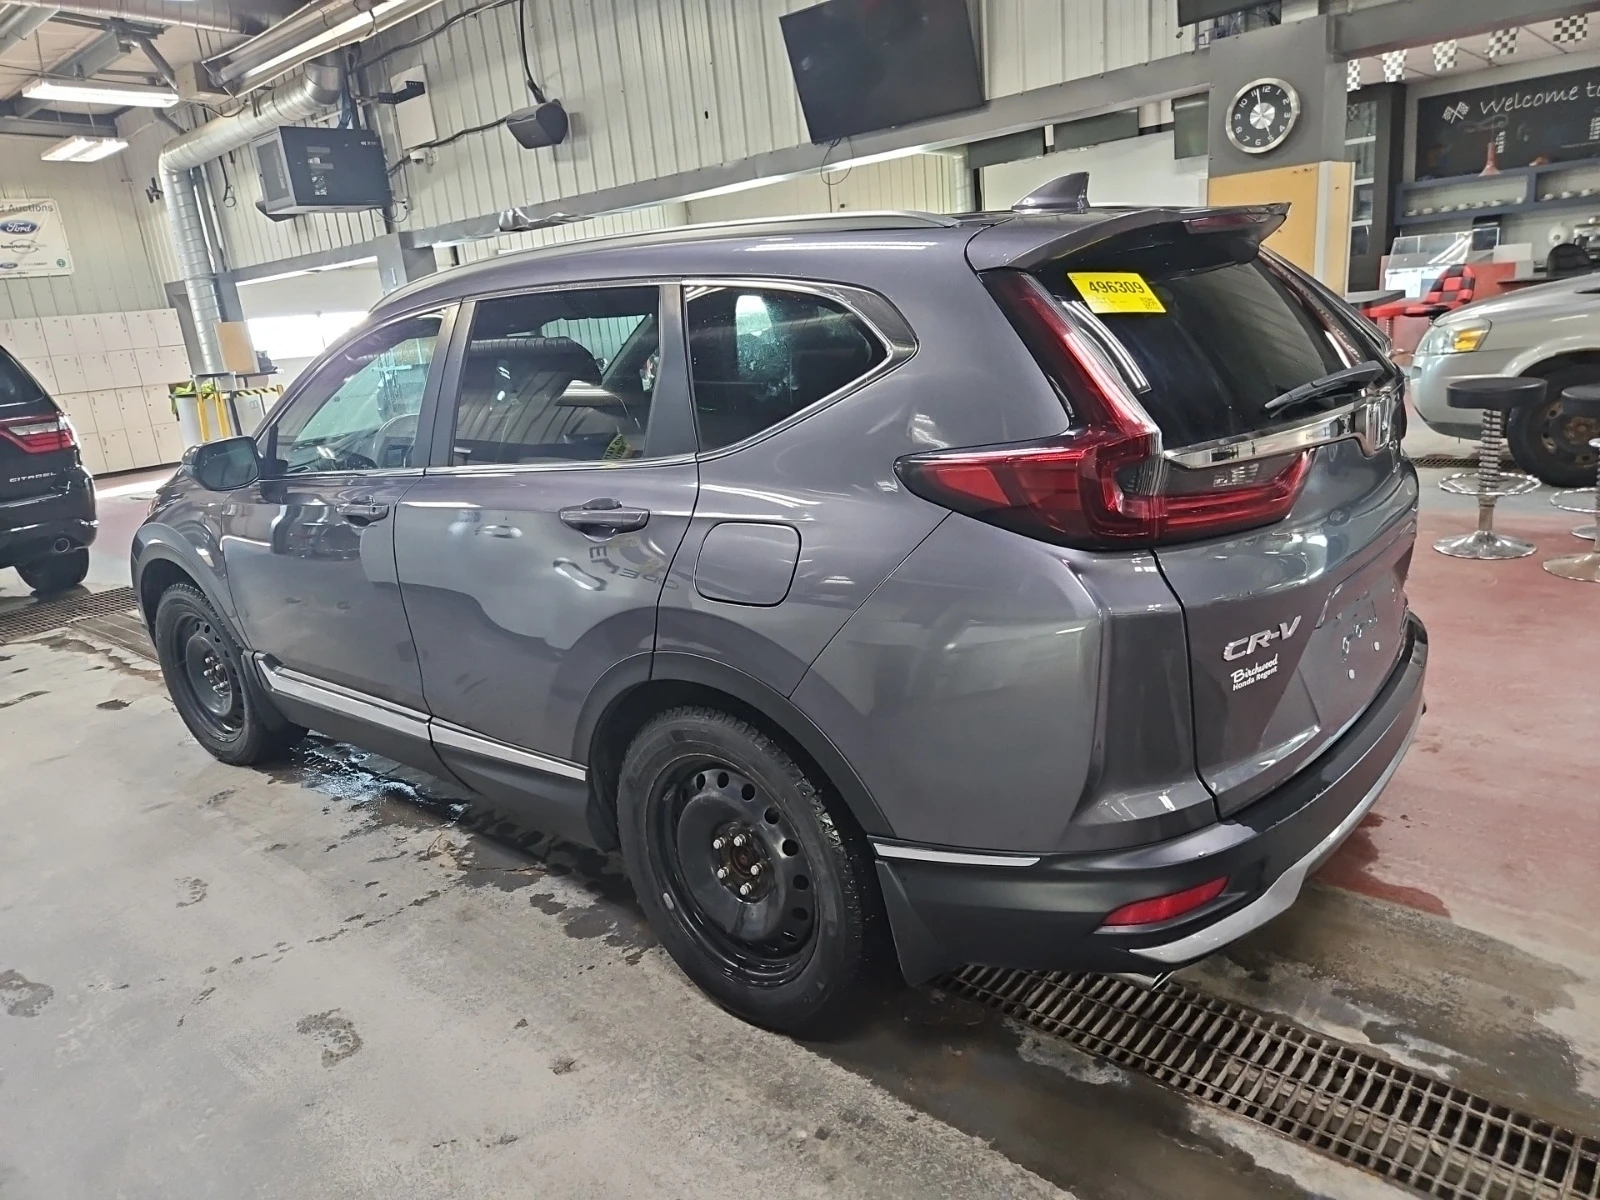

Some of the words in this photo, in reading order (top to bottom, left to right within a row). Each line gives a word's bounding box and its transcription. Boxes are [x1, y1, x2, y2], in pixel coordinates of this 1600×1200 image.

[1480, 85, 1579, 115] Welcome
[8, 203, 54, 213] Auctions
[6, 222, 32, 233] Ford
[1089, 281, 1146, 294] 496309
[9, 471, 57, 483] CITADEL
[1223, 615, 1302, 661] CR-V
[1230, 653, 1278, 684] Birchwood
[1232, 676, 1255, 691] Honda
[1256, 665, 1278, 682] Regent
